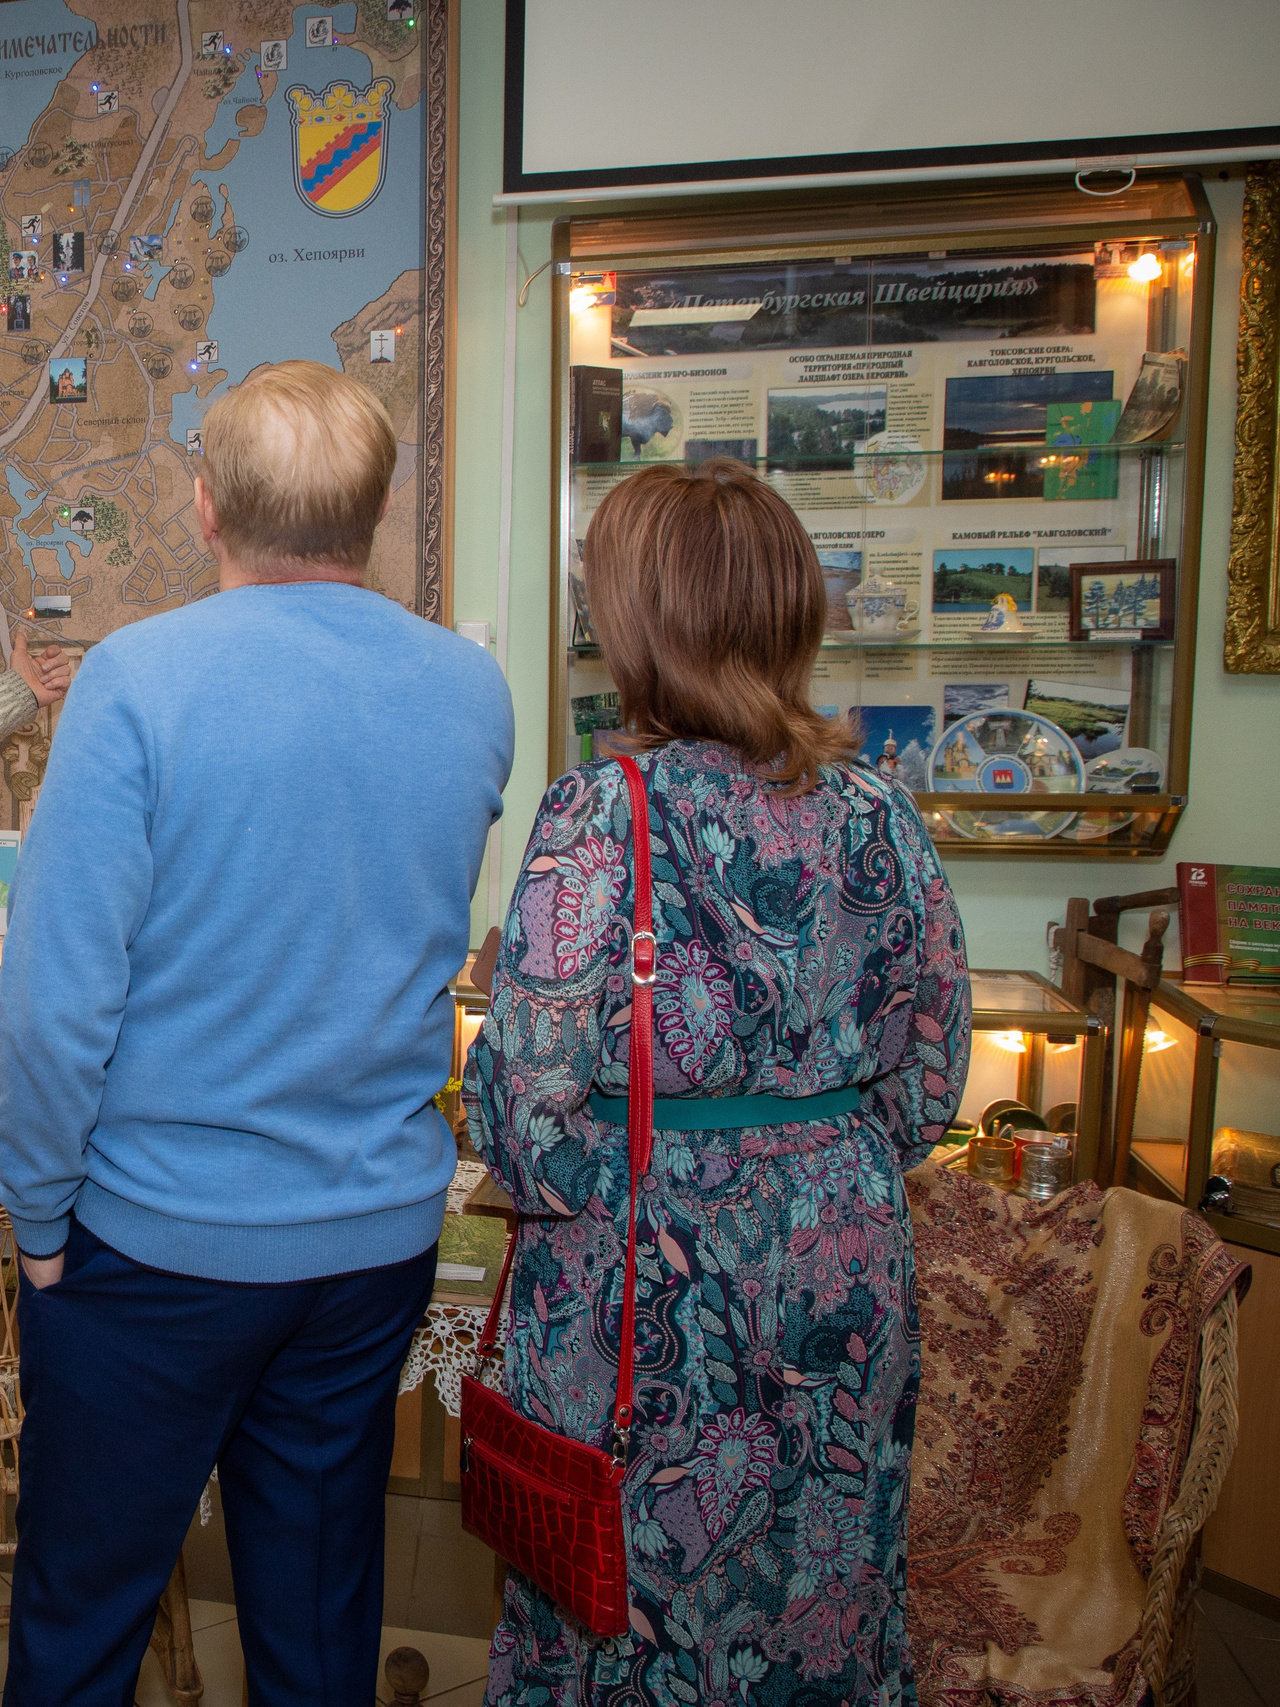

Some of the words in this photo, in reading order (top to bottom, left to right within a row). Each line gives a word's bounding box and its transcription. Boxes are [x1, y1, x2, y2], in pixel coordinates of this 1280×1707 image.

[5, 65, 64, 82] Курголовское
[232, 95, 258, 105] Чайное
[268, 252, 288, 263] оз.
[293, 247, 366, 262] Хепоярви
[669, 287, 866, 315] «Петербургская
[873, 276, 1039, 304] Швейцария»
[62, 333, 71, 346] ул.
[70, 300, 90, 332] Советов
[989, 346, 1046, 357] ТОКСОВСКИЕ
[1046, 345, 1073, 354] ОЗЕРА:
[788, 355, 815, 364] ОСОБО
[815, 352, 867, 362] ОХРАНЯЕМАЯ
[967, 357, 1034, 368] КАВГОЛОВСКОЕ,
[1034, 354, 1096, 366] КУРГОЛЬСКОЕ,
[662, 367, 728, 379] ЗУБРО-БИЗОНОВ
[803, 363, 852, 373] ТЕРРИТОРИЯ
[1011, 366, 1057, 376] ХЕПОЯРВИ
[798, 373, 841, 383] ЛАНДШАФТ
[842, 372, 865, 381] ОЗЕРА
[76, 415, 120, 427] Северный
[121, 417, 146, 426] склон
[808, 531, 861, 540] АВГОЛОВСКОЕ
[951, 529, 996, 541] КАМОВЫЙ
[997, 529, 1032, 539] РЕЛЬЕФ
[1032, 526, 1112, 539] "КАВГОЛОВСКИЙ"
[39, 538, 65, 548] Вероярви
[1228, 917, 1249, 929] НА
